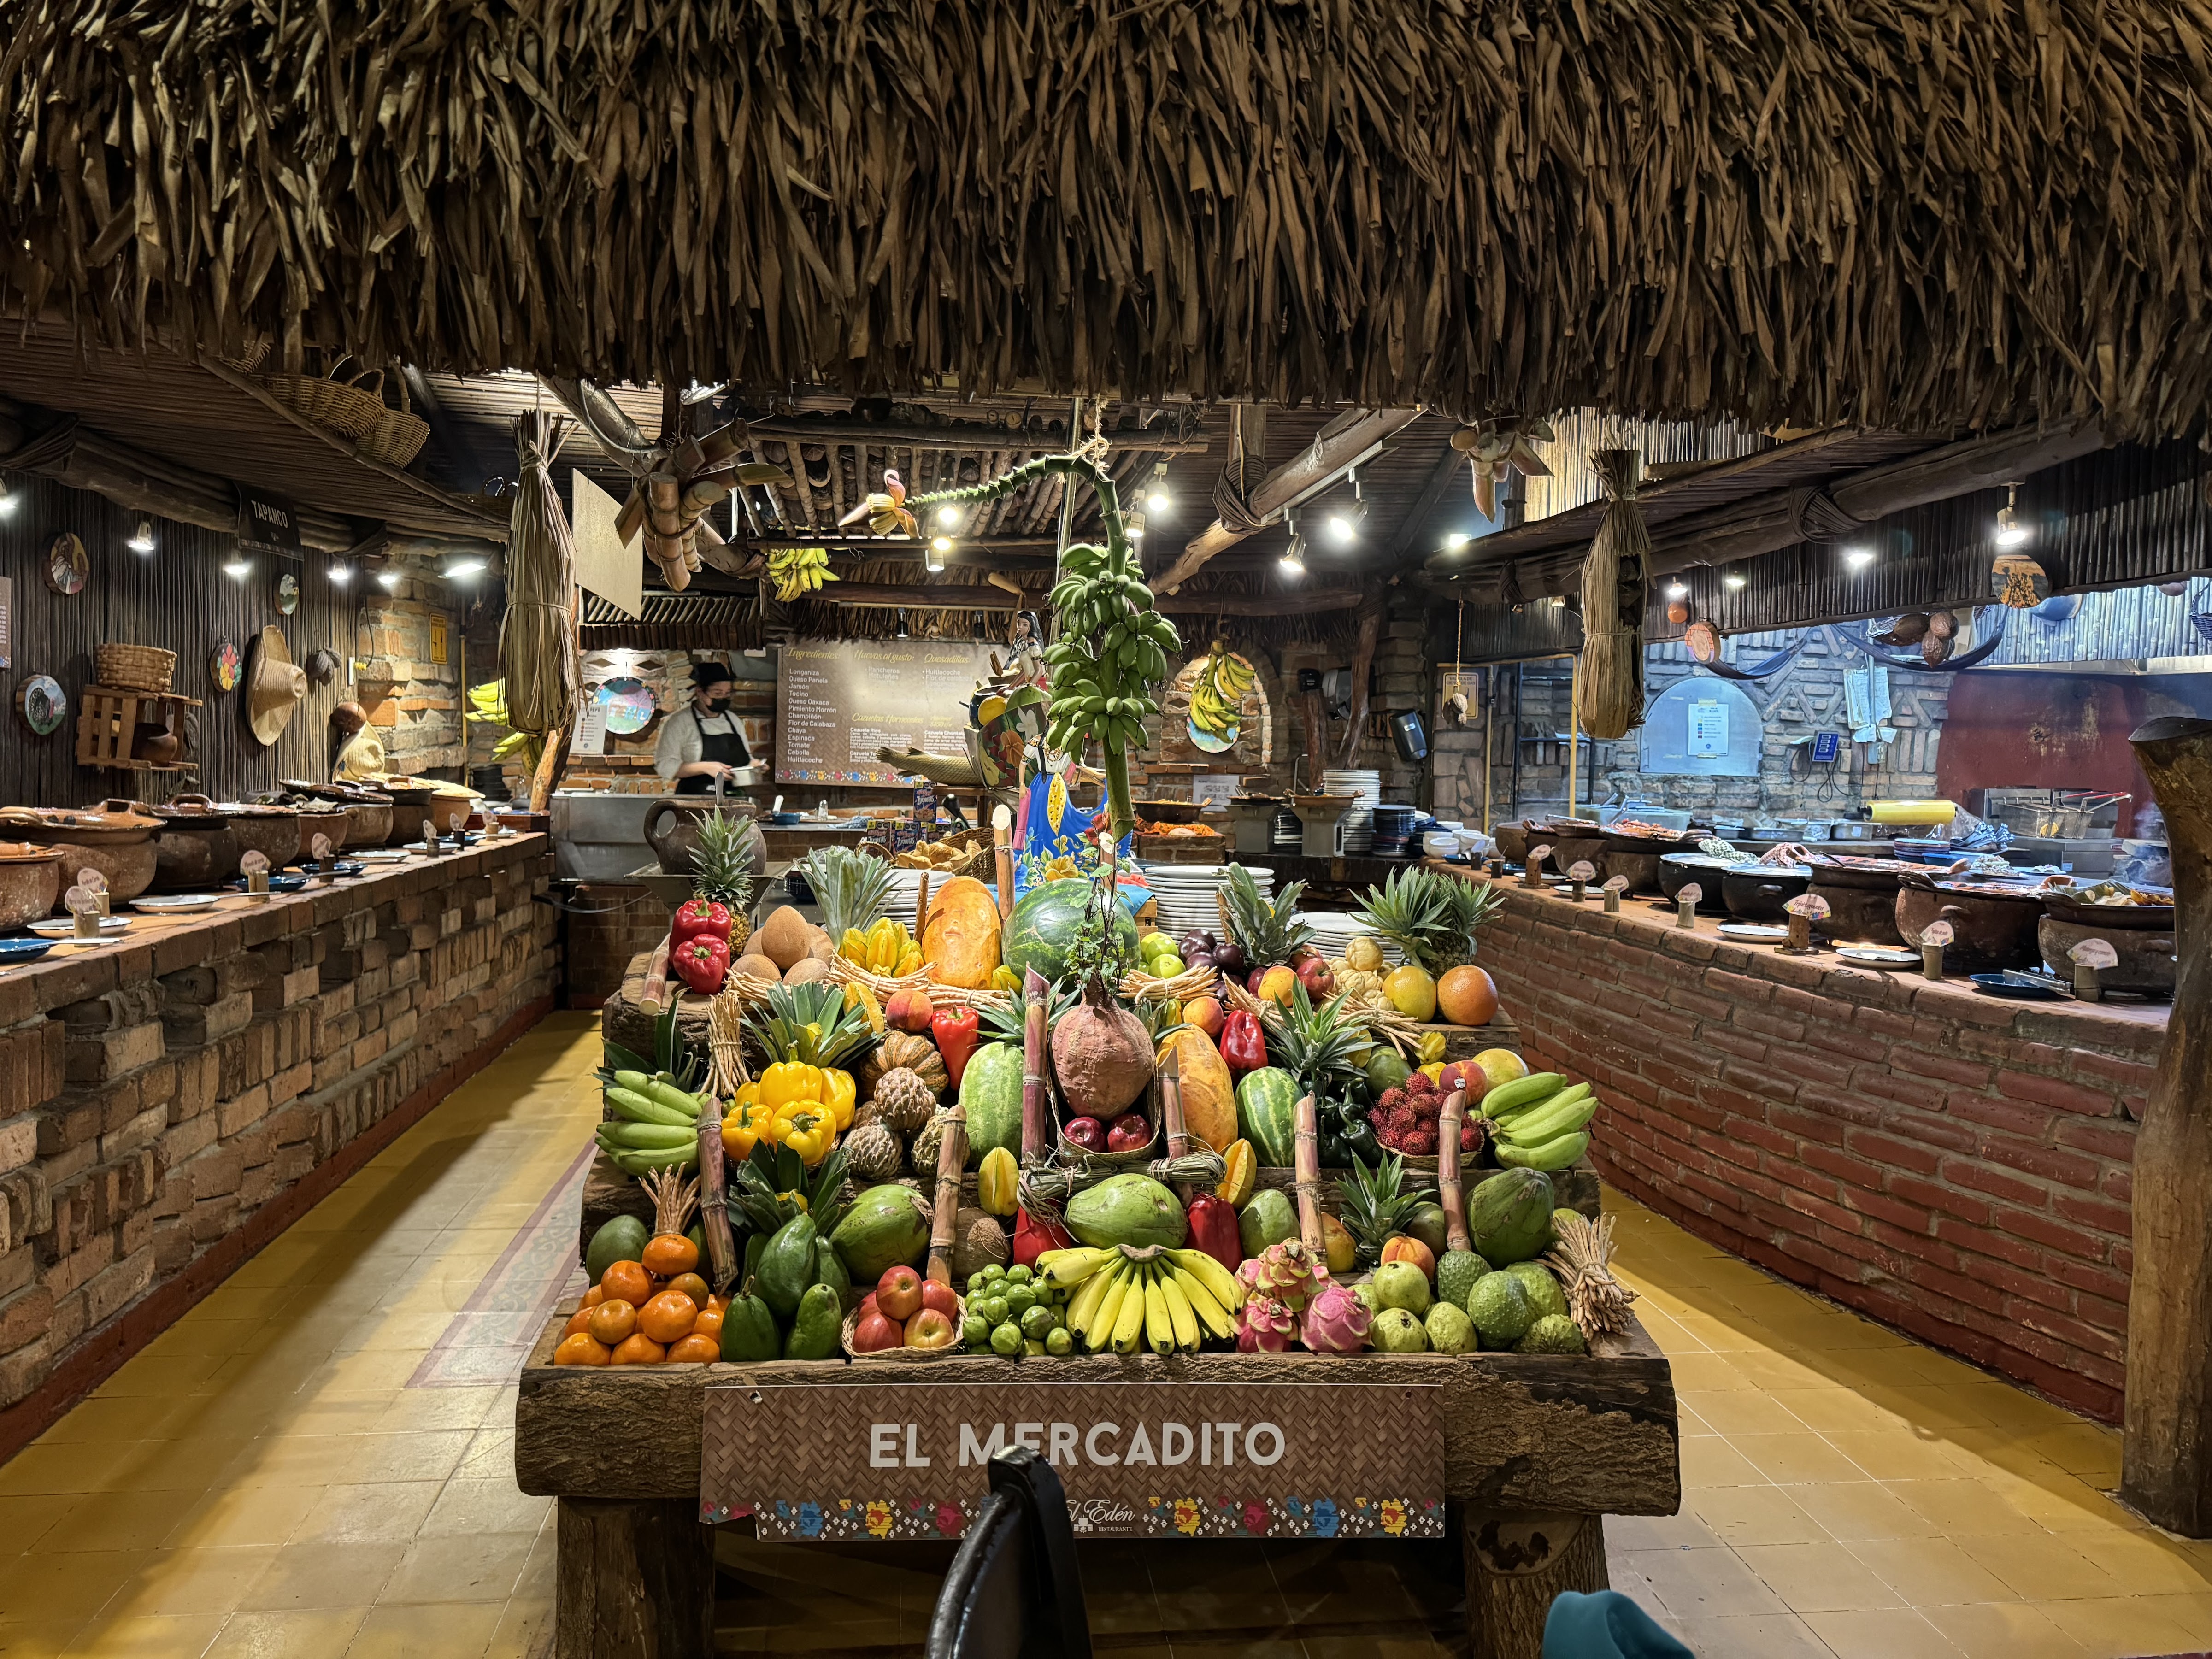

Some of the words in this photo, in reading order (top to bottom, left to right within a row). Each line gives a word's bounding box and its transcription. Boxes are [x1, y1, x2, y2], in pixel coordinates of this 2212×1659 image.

[251, 500, 288, 529] TAPANCO
[785, 647, 840, 660] Ingredientes:
[854, 649, 882, 660] Huevos
[924, 653, 971, 663] Quesadillas:
[870, 1424, 930, 1467] EL
[959, 1421, 1285, 1466] MERCADITO
[1084, 1499, 1135, 1524] Edén
